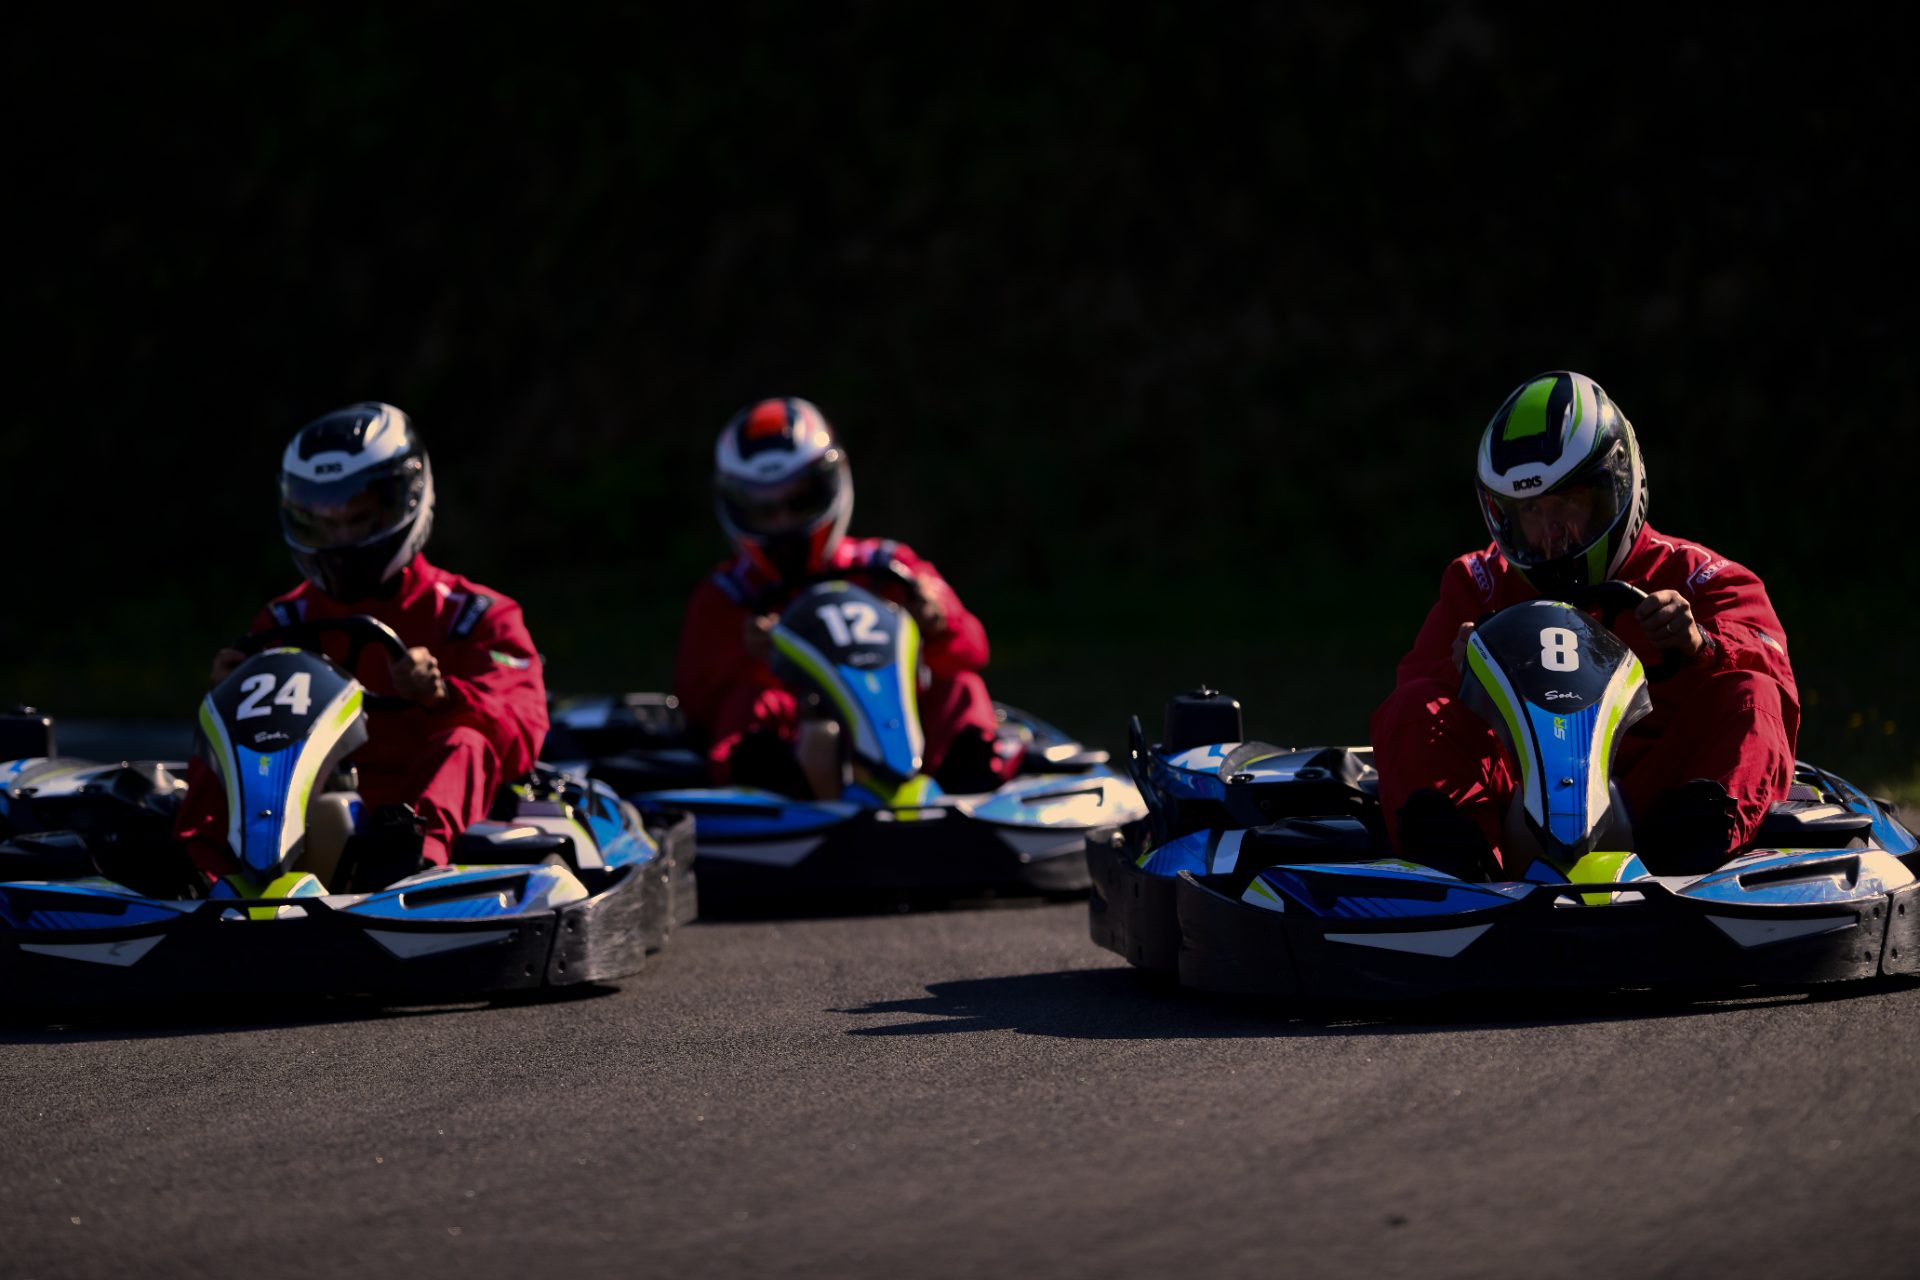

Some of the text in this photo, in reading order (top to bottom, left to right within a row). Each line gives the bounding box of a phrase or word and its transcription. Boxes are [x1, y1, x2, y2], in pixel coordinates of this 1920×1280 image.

[815, 601, 891, 647] 12
[1540, 627, 1580, 672] 8
[236, 672, 312, 721] 24
